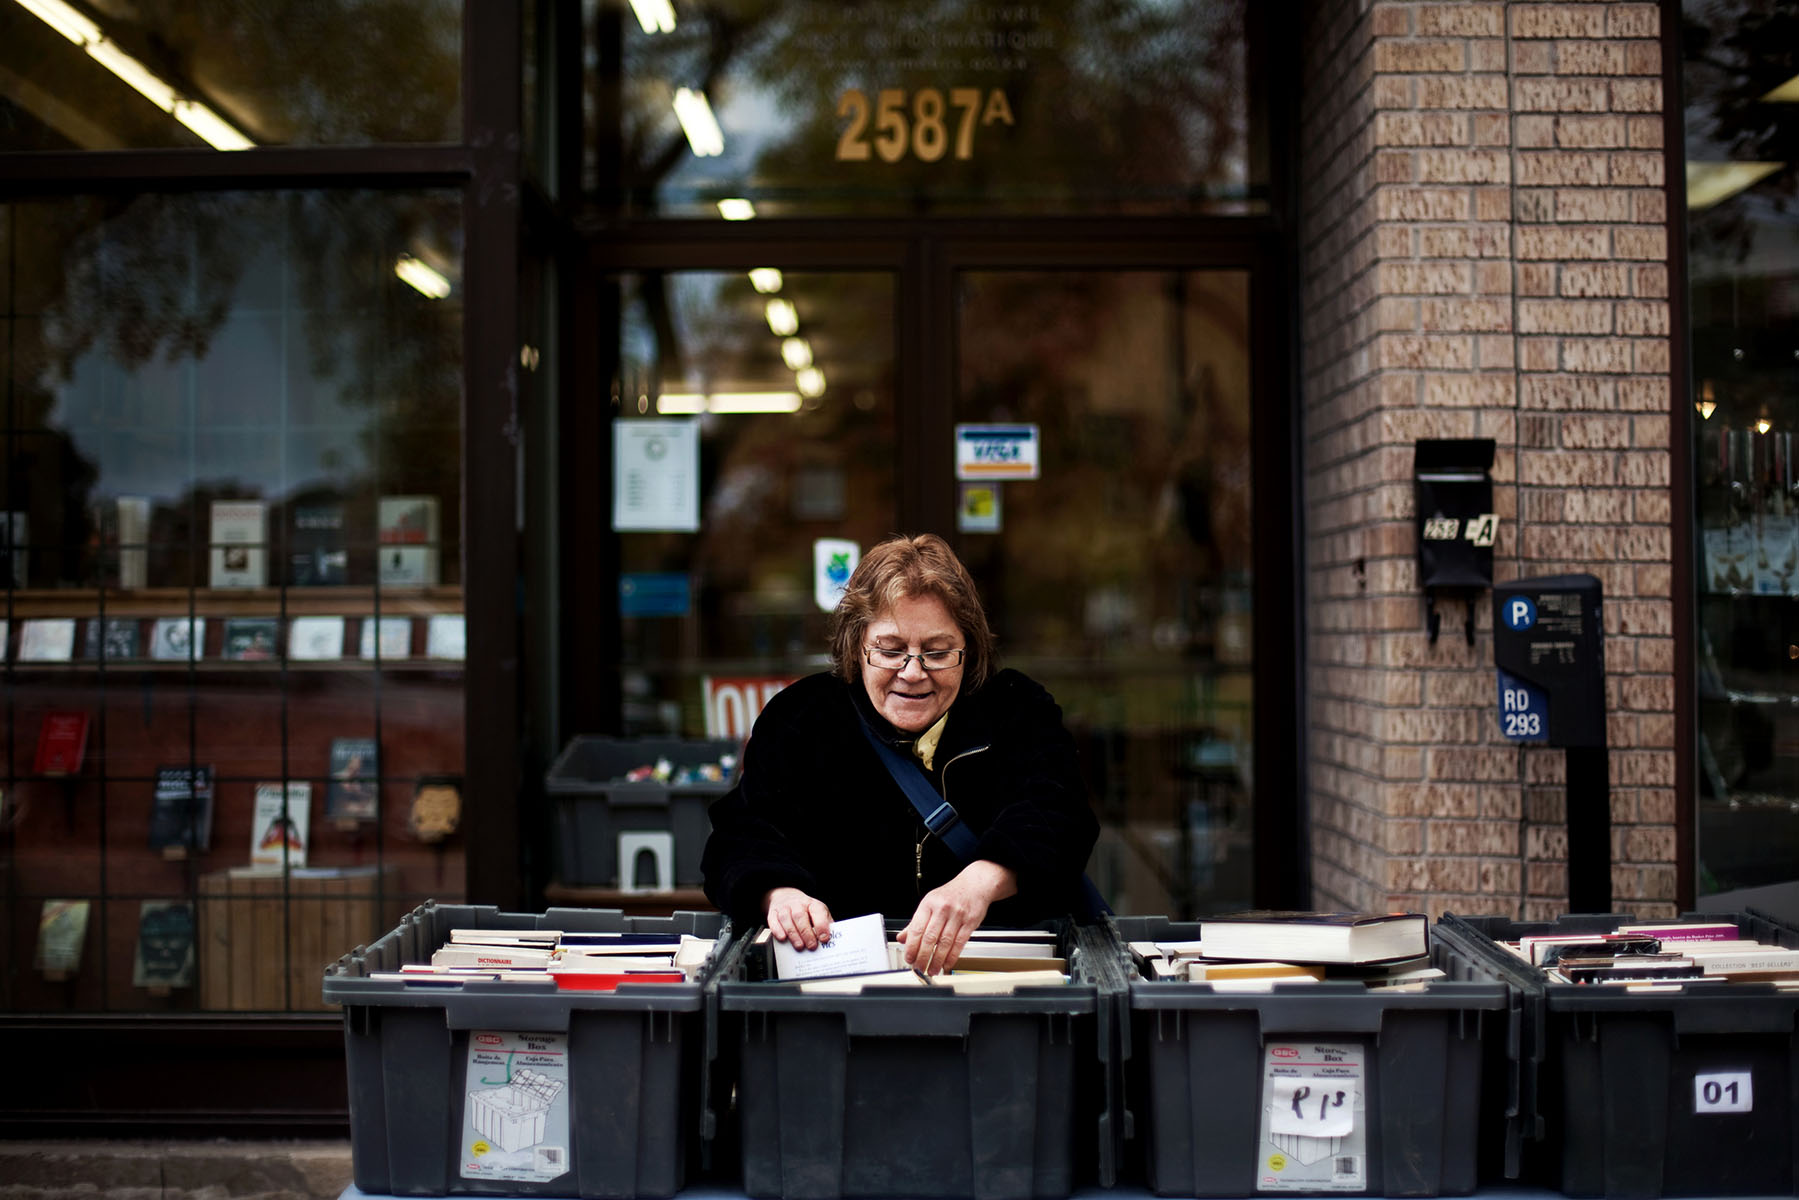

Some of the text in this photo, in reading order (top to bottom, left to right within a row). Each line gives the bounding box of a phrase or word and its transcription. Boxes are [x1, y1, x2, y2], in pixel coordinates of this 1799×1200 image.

[1503, 688, 1530, 712] RD
[1505, 712, 1541, 736] 293
[477, 957, 512, 965] DICTIONNAIRE
[1711, 962, 1746, 970] COLLECTION
[518, 1034, 557, 1045] Storage
[1324, 1054, 1343, 1062] Box
[1703, 1081, 1739, 1105] 01
